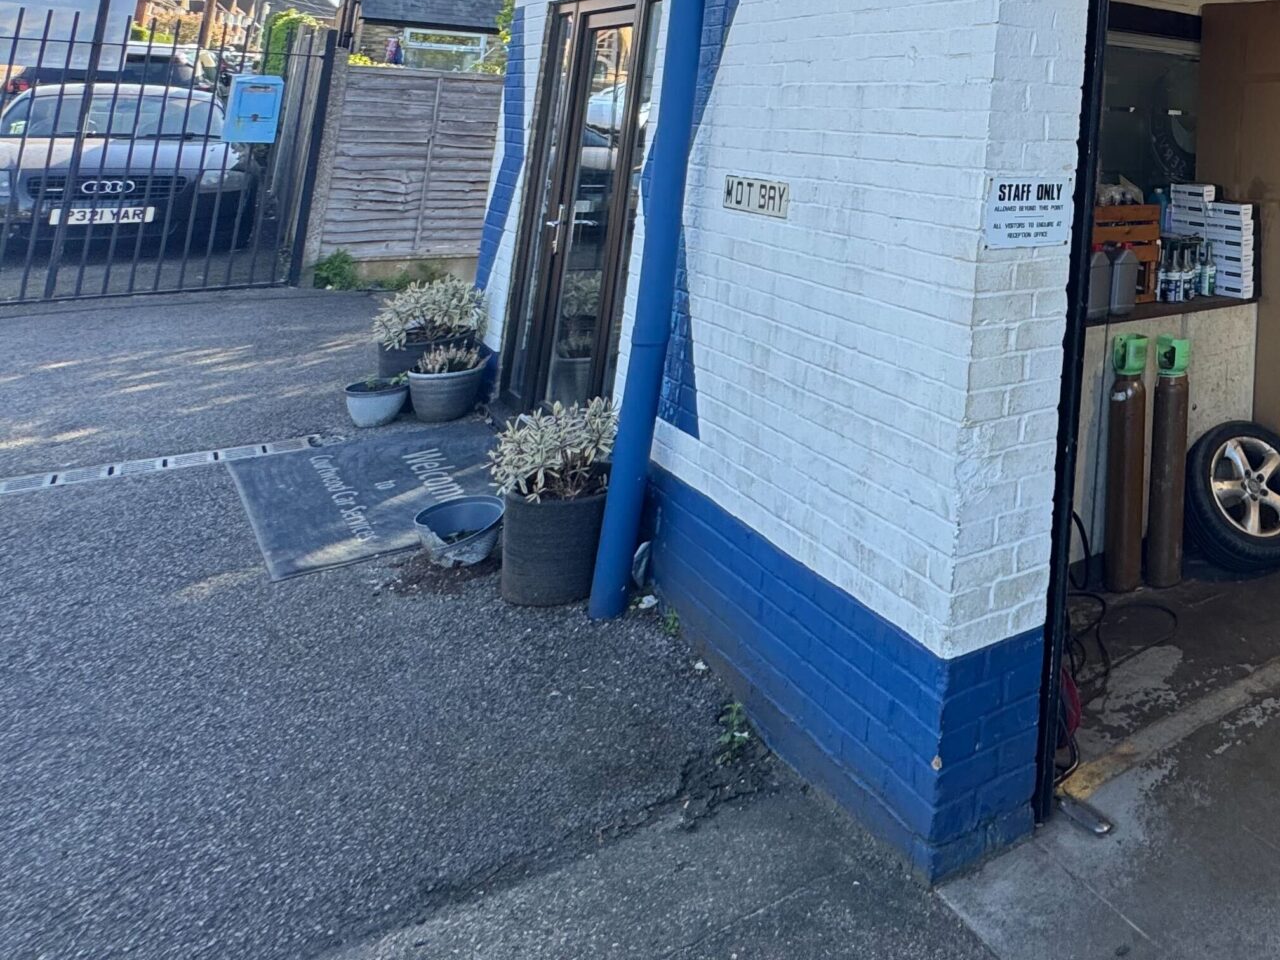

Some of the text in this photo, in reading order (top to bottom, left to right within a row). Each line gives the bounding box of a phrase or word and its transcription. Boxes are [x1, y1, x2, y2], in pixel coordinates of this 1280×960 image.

[725, 178, 786, 213] MOT BAY
[998, 183, 1063, 201] STAFF ONLY
[110, 209, 144, 222] YAR
[374, 479, 396, 490] to
[402, 448, 468, 501] Welcom
[309, 454, 382, 542] Courtwood Car Services
